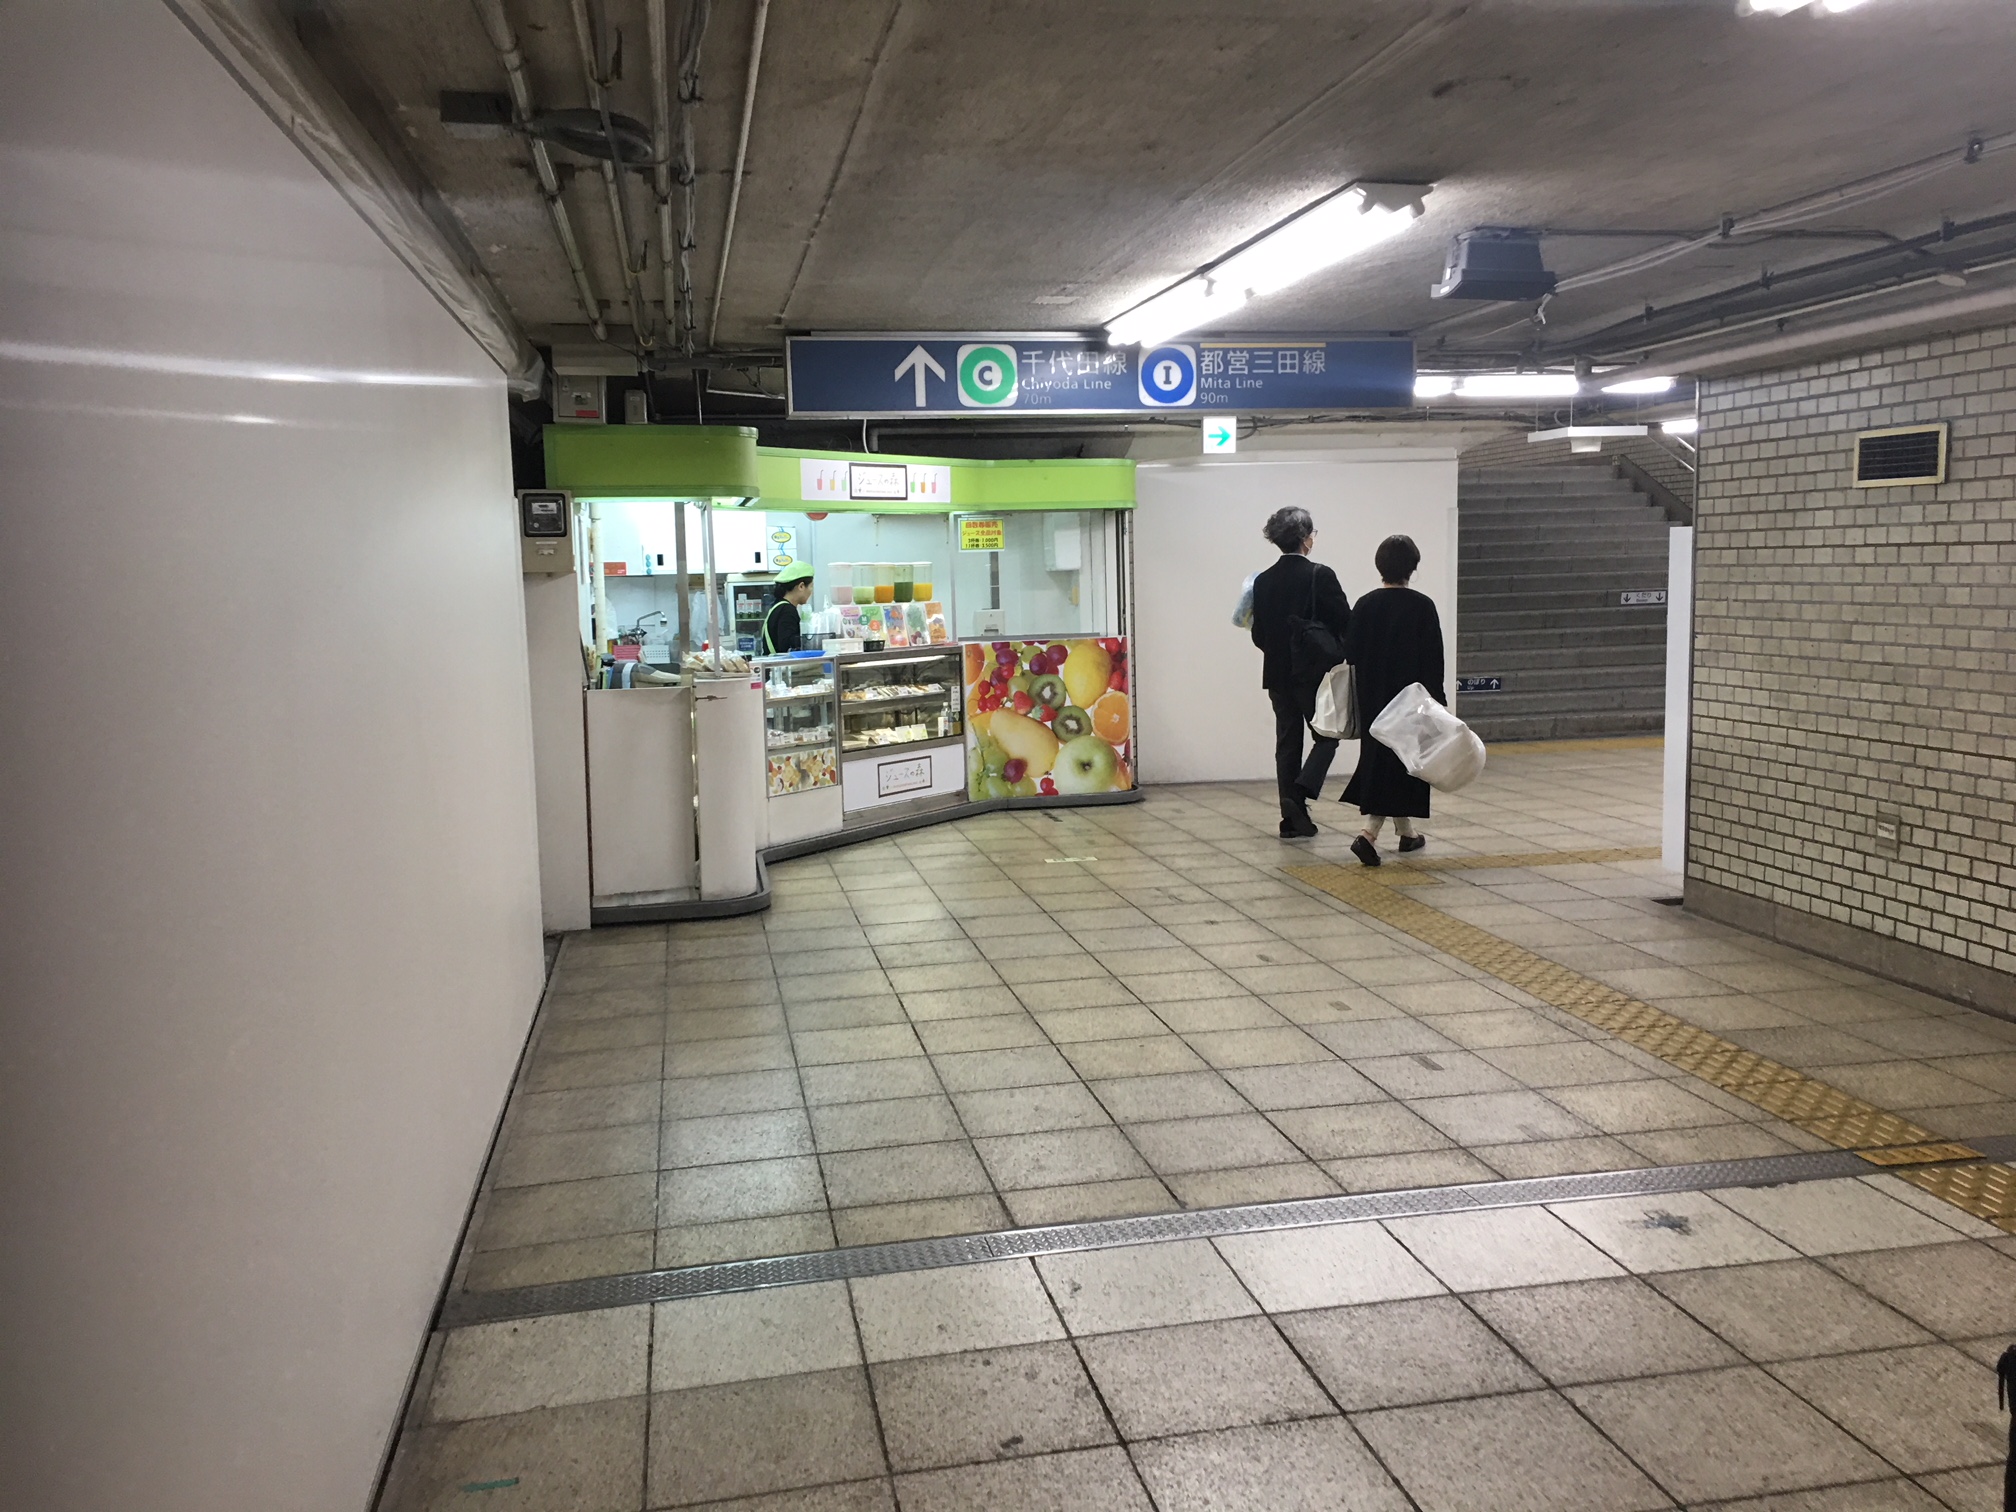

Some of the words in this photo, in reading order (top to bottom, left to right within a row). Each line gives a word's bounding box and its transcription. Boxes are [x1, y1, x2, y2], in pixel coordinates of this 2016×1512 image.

[1021, 350, 1128, 376] 千代田線
[1200, 350, 1327, 376] 都営三田線
[978, 365, 993, 386] C
[1163, 365, 1172, 385] I
[1200, 377, 1231, 389] Mita
[1235, 377, 1264, 389] Line
[1021, 377, 1079, 392] Chiyoda
[1083, 378, 1112, 390] Line
[1023, 393, 1052, 405] 70m
[1200, 391, 1229, 404] 90m
[857, 471, 900, 487] ジュースの森
[886, 762, 926, 783] ジュースの森
